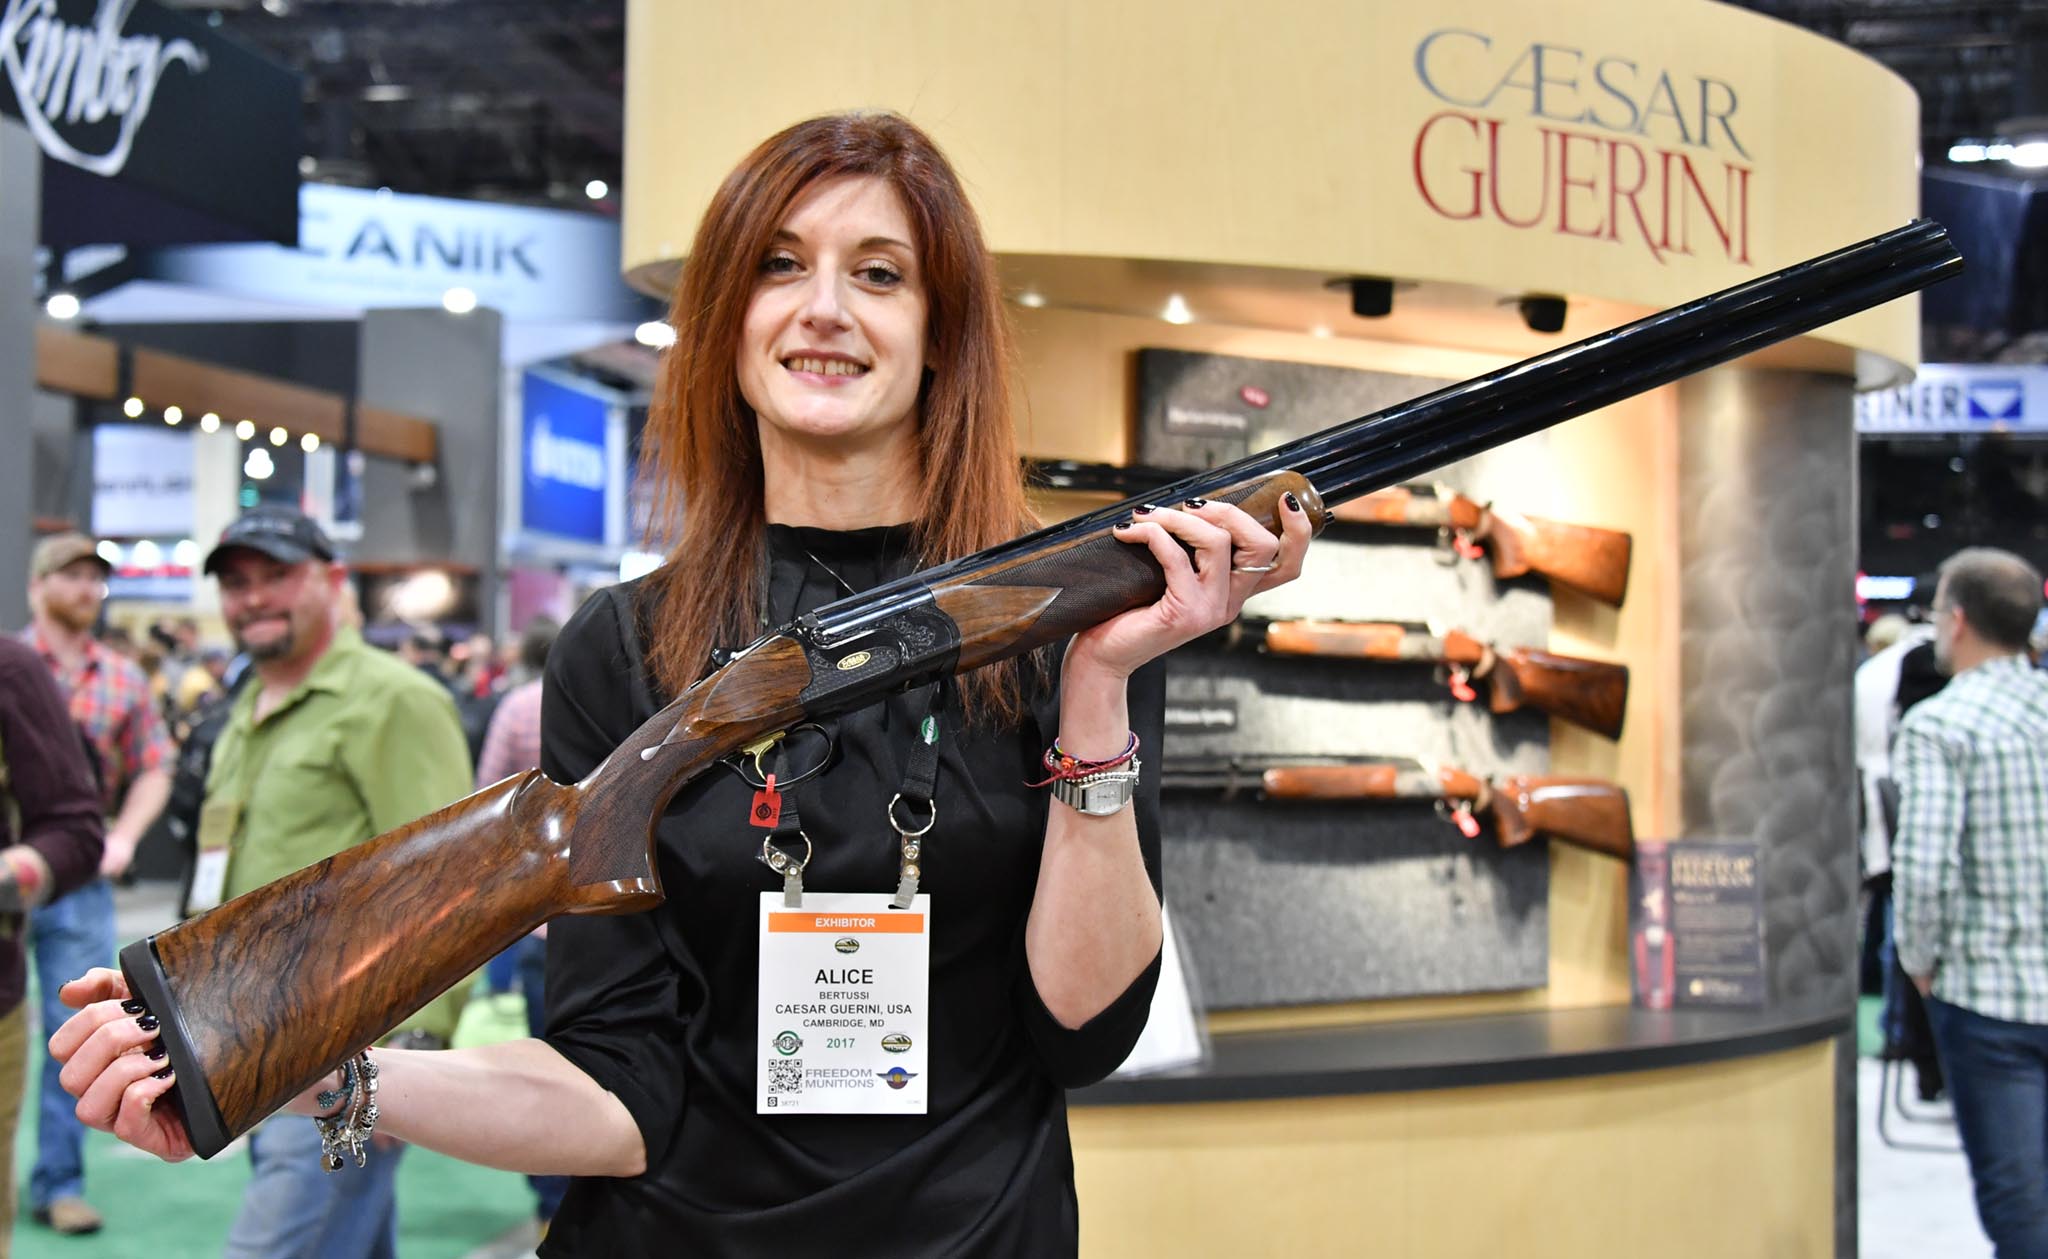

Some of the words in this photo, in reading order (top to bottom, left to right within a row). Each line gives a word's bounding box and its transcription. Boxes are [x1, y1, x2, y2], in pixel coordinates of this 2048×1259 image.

[1412, 111, 1754, 267] GUERINI
[815, 918, 876, 928] EXHIBITOR
[815, 969, 873, 984] ALICE
[819, 991, 869, 1000] BERTUSSI
[775, 1004, 826, 1014] CAESAR
[830, 1004, 883, 1015] GUERINI,
[887, 1004, 912, 1014] USA
[802, 1019, 866, 1028] CAMBRIDGE,
[869, 1019, 885, 1027] MD
[826, 1038, 855, 1048] 2017
[805, 1068, 872, 1078] FREEDOM
[805, 1079, 874, 1088] MUNITIONS
